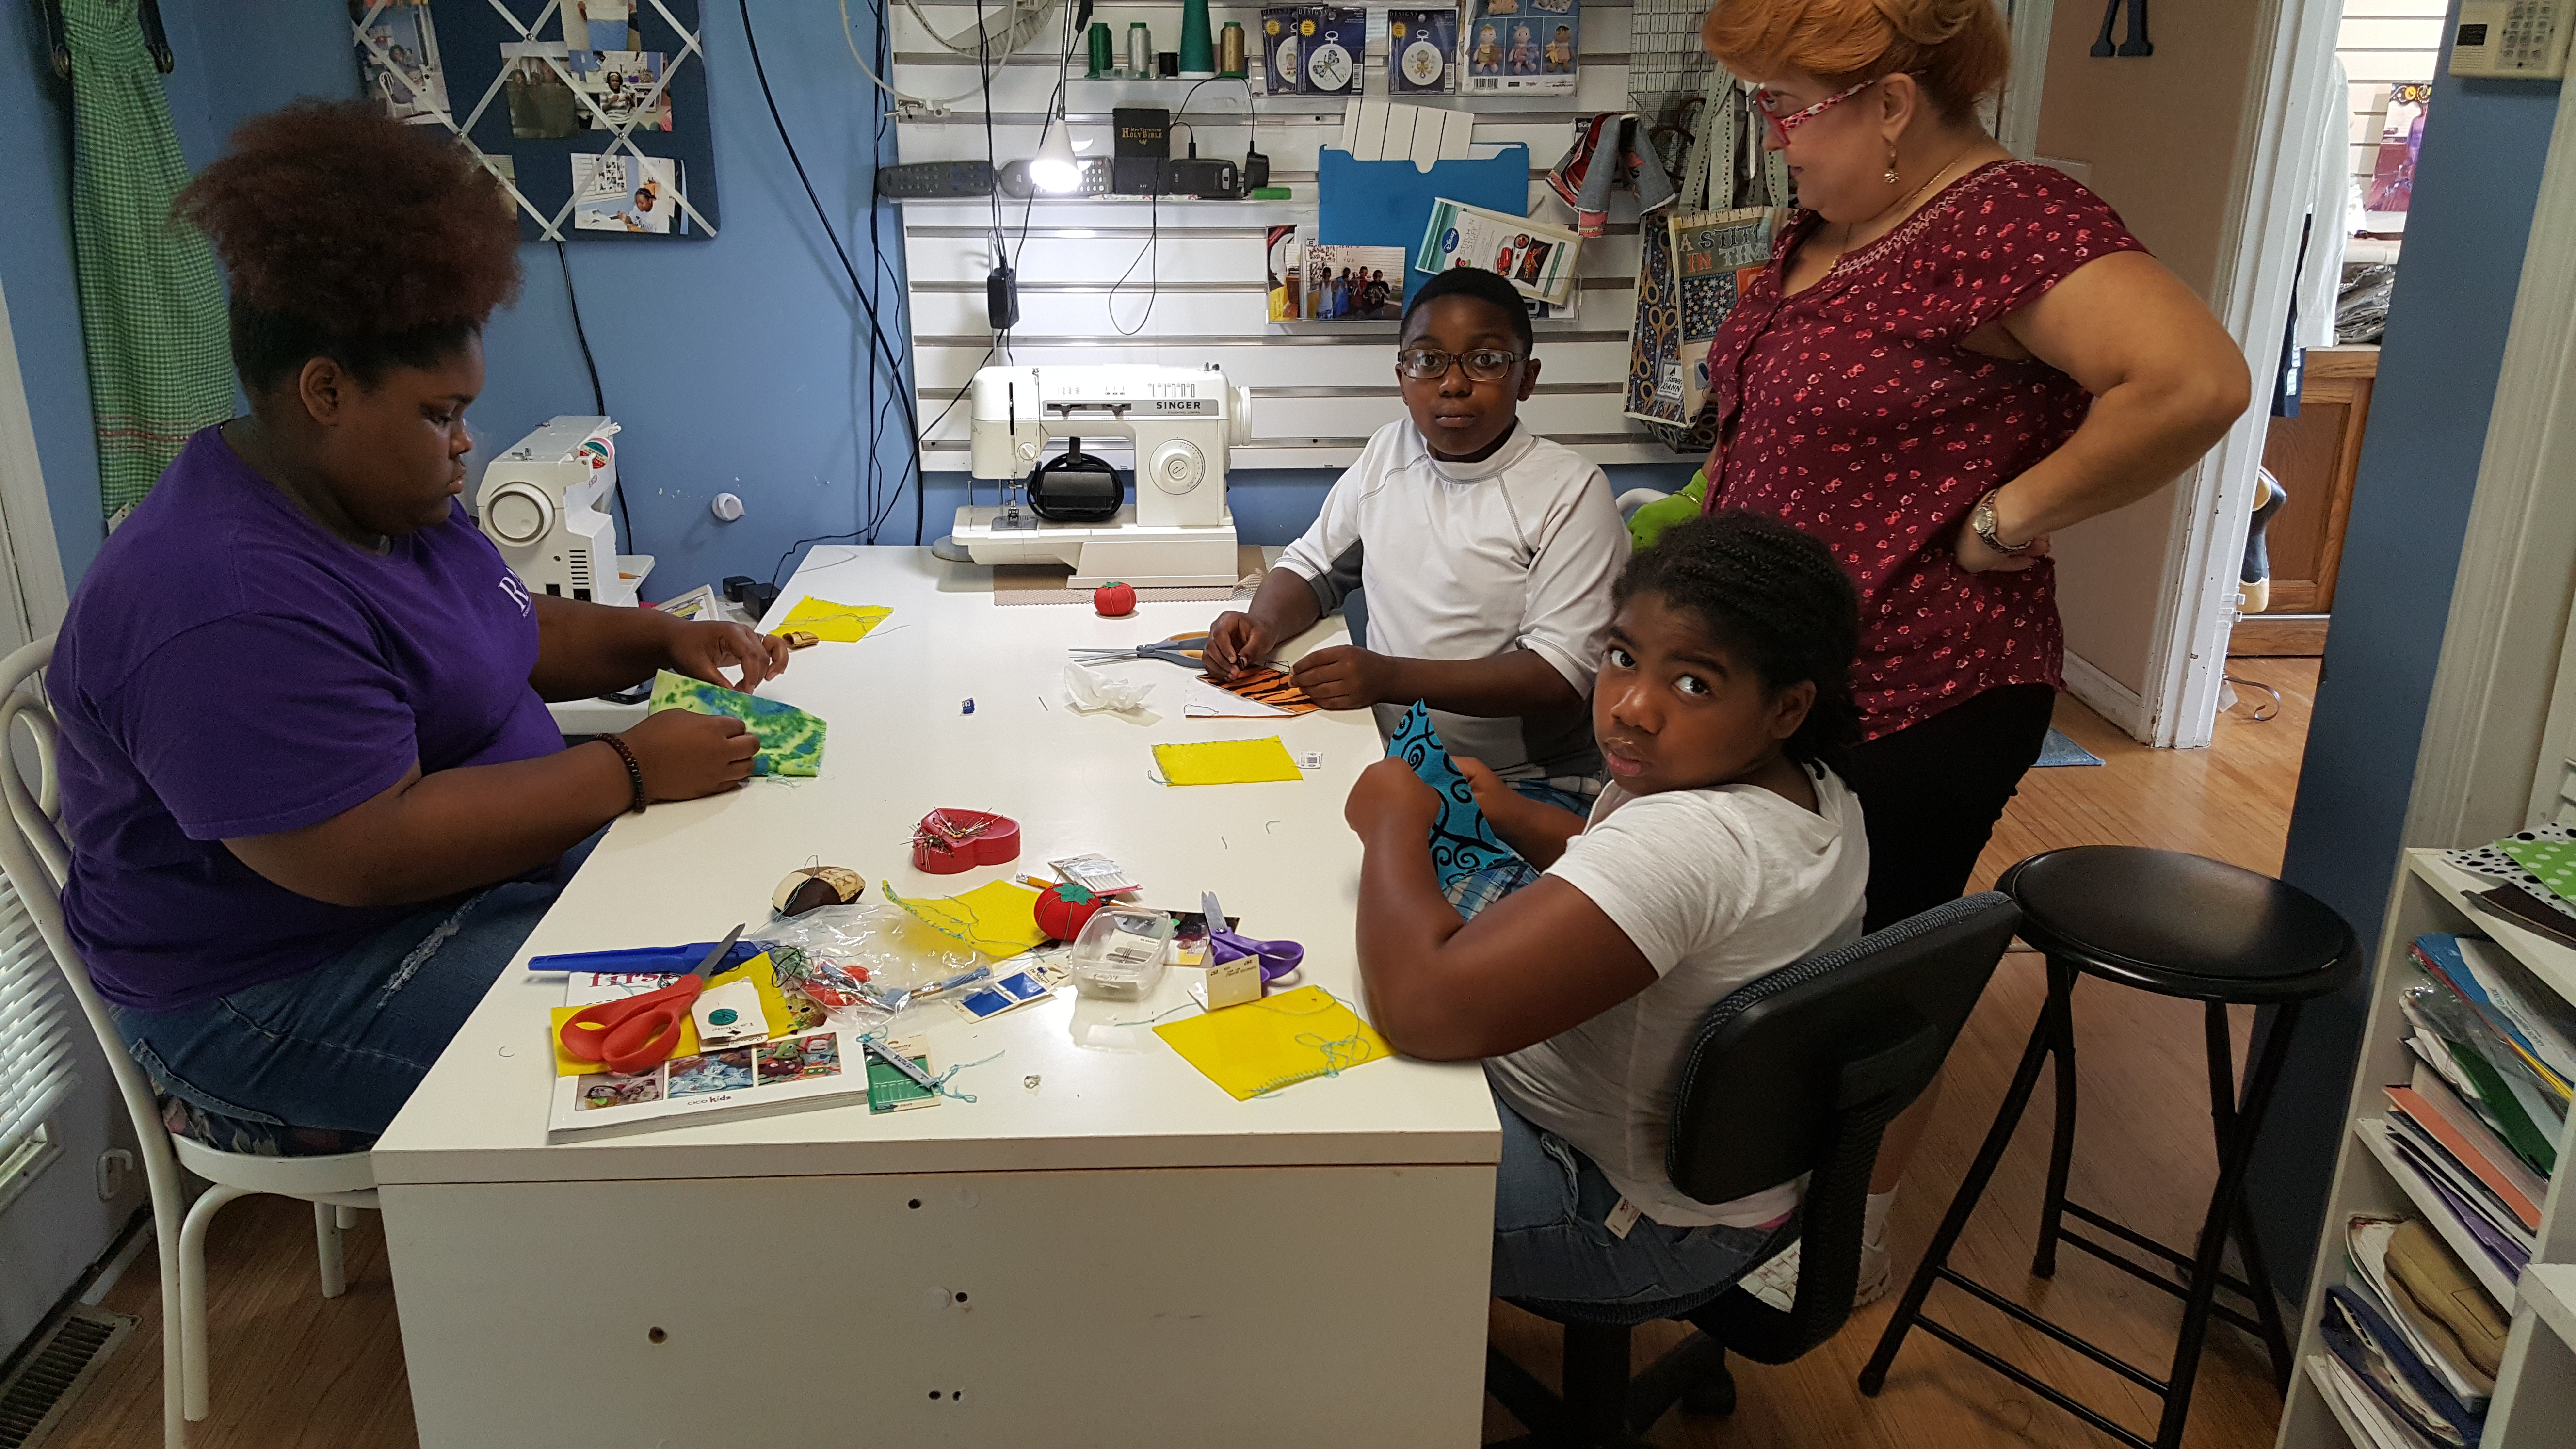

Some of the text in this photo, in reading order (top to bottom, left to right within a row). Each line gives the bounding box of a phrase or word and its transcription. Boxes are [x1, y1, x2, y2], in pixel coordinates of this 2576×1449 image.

[1122, 128, 1162, 138] HOLY BIBLE
[1459, 228, 1470, 255] STITCH
[1466, 226, 1478, 249] STUFF
[1679, 233, 1694, 251] A
[1688, 251, 1712, 273] IN
